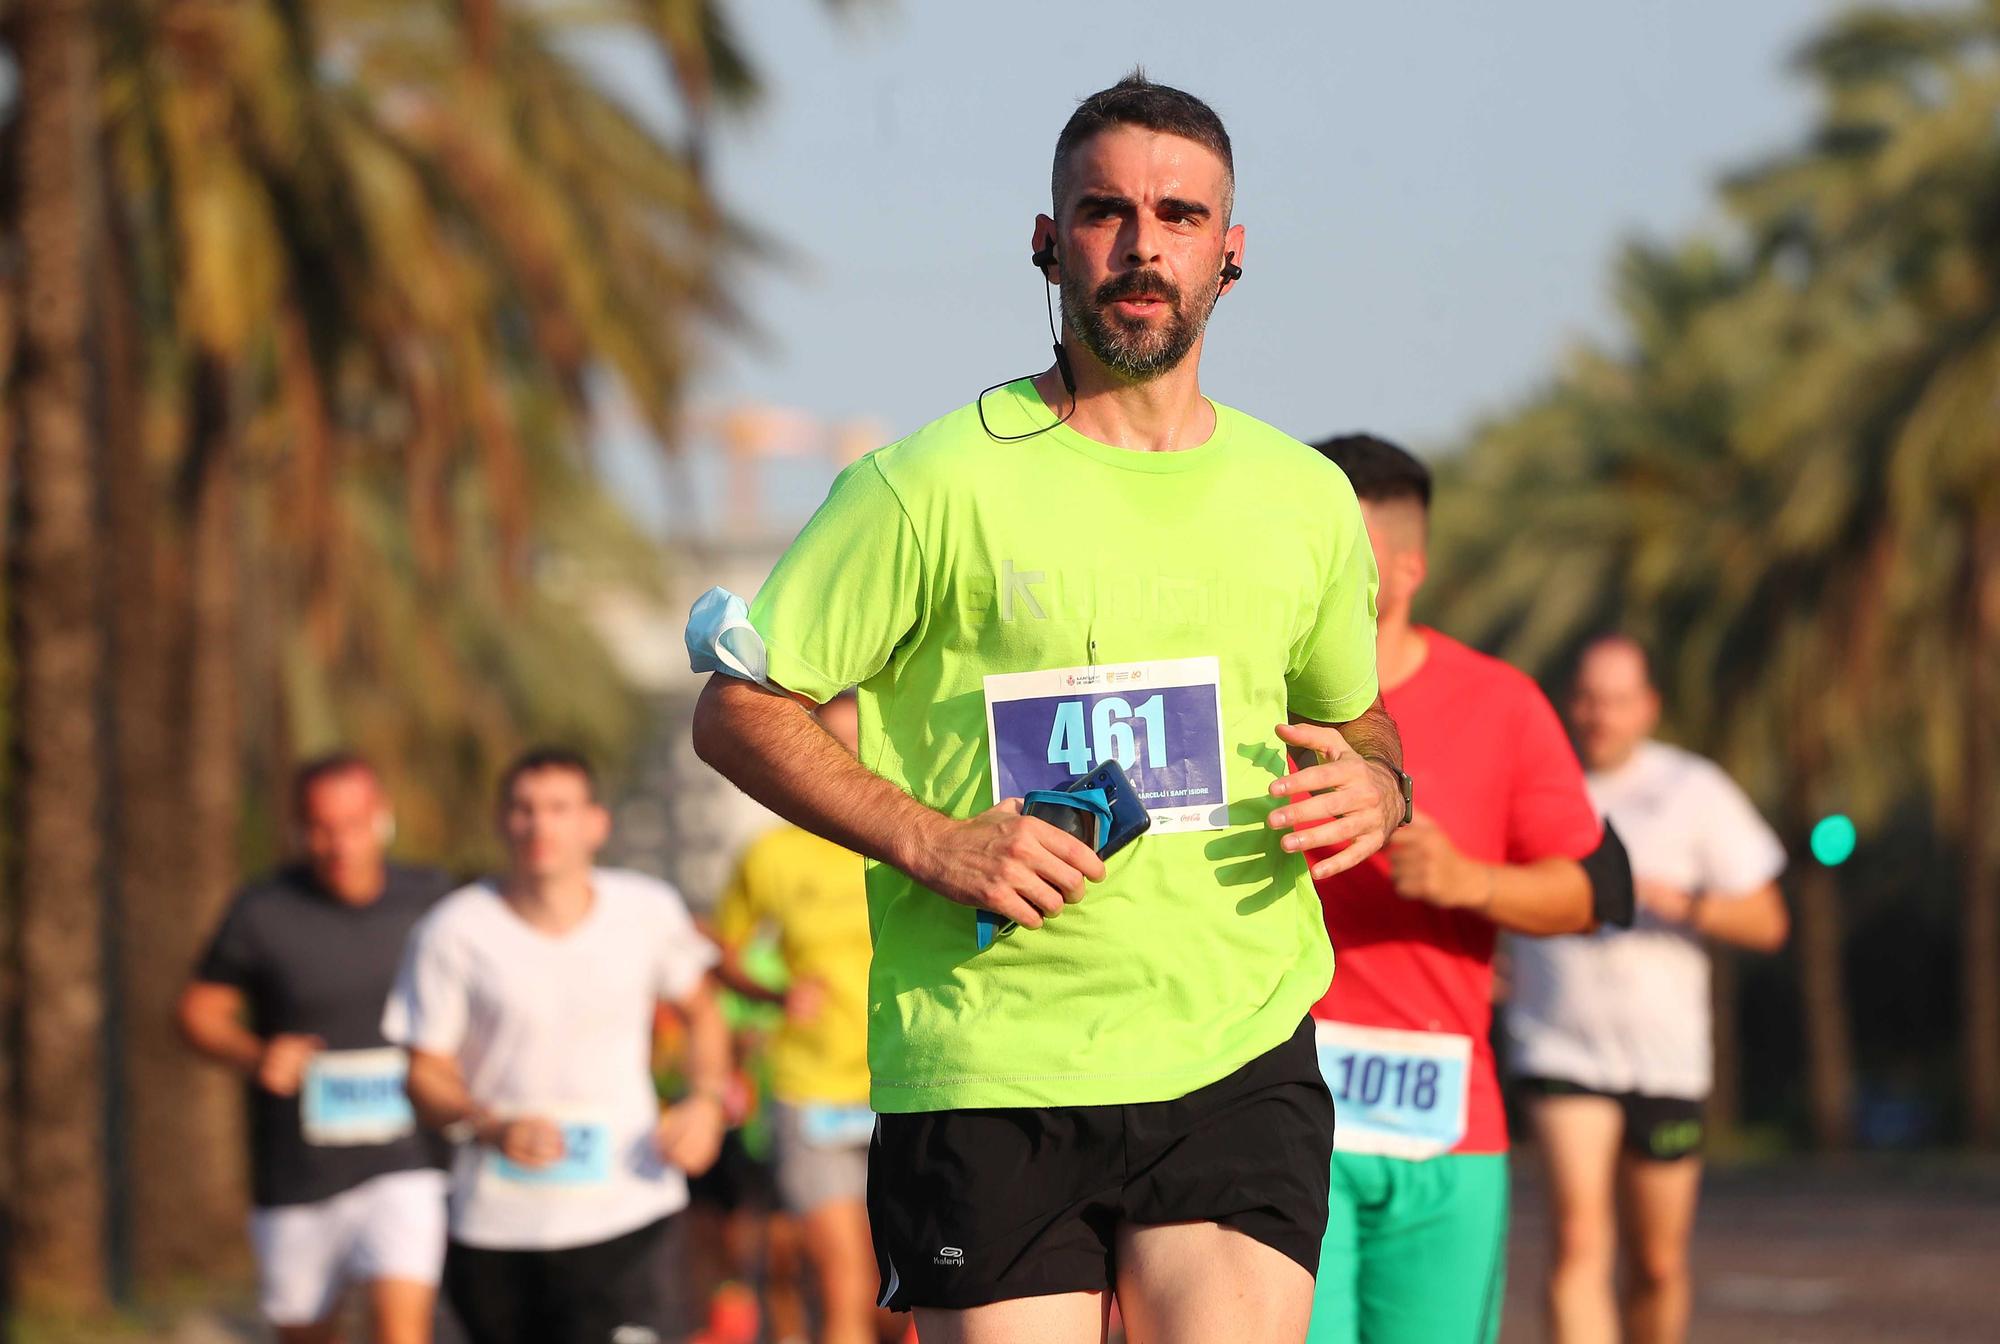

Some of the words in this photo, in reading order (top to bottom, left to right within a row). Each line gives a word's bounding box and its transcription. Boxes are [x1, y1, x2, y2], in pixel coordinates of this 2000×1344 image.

[1047, 694, 1168, 775] 461
[1170, 789, 1187, 797] SANT
[1188, 787, 1209, 795] ISIDRE
[1338, 1052, 1440, 1112] 1018
[933, 1256, 965, 1268] Kalenji
